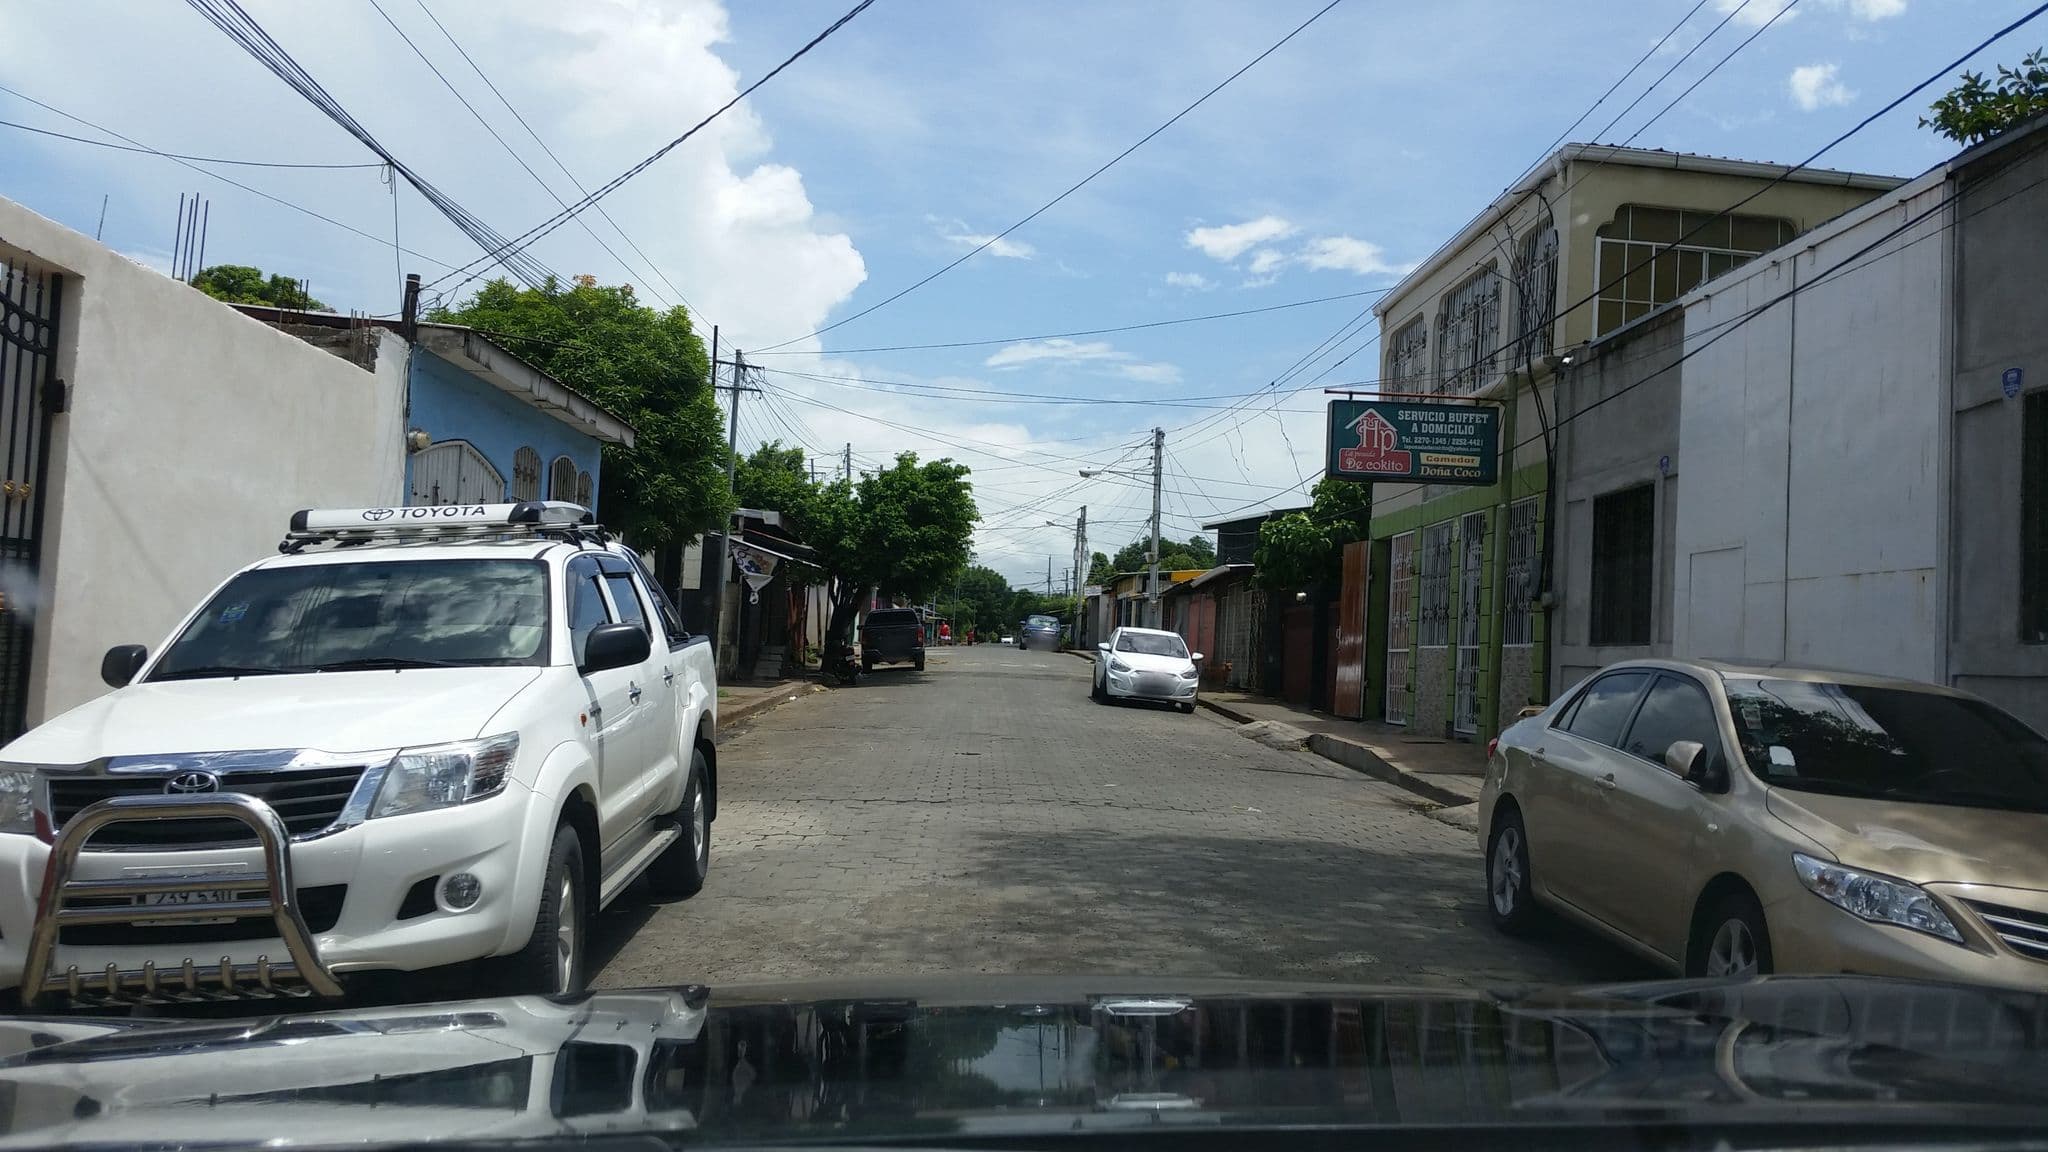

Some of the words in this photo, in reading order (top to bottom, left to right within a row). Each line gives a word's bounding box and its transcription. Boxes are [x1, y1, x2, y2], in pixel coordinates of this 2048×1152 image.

[1398, 410, 1446, 422] SERVICIO
[1448, 412, 1489, 424] BUFFET
[1411, 422, 1419, 433] A
[1421, 423, 1475, 436] DOMICILIO
[1345, 457, 1363, 470] De
[1366, 459, 1404, 472] cokito
[1426, 455, 1476, 464] Comedor
[1420, 466, 1451, 478] Doña
[1454, 467, 1481, 478] Coco
[400, 506, 486, 518] TOYOTA
